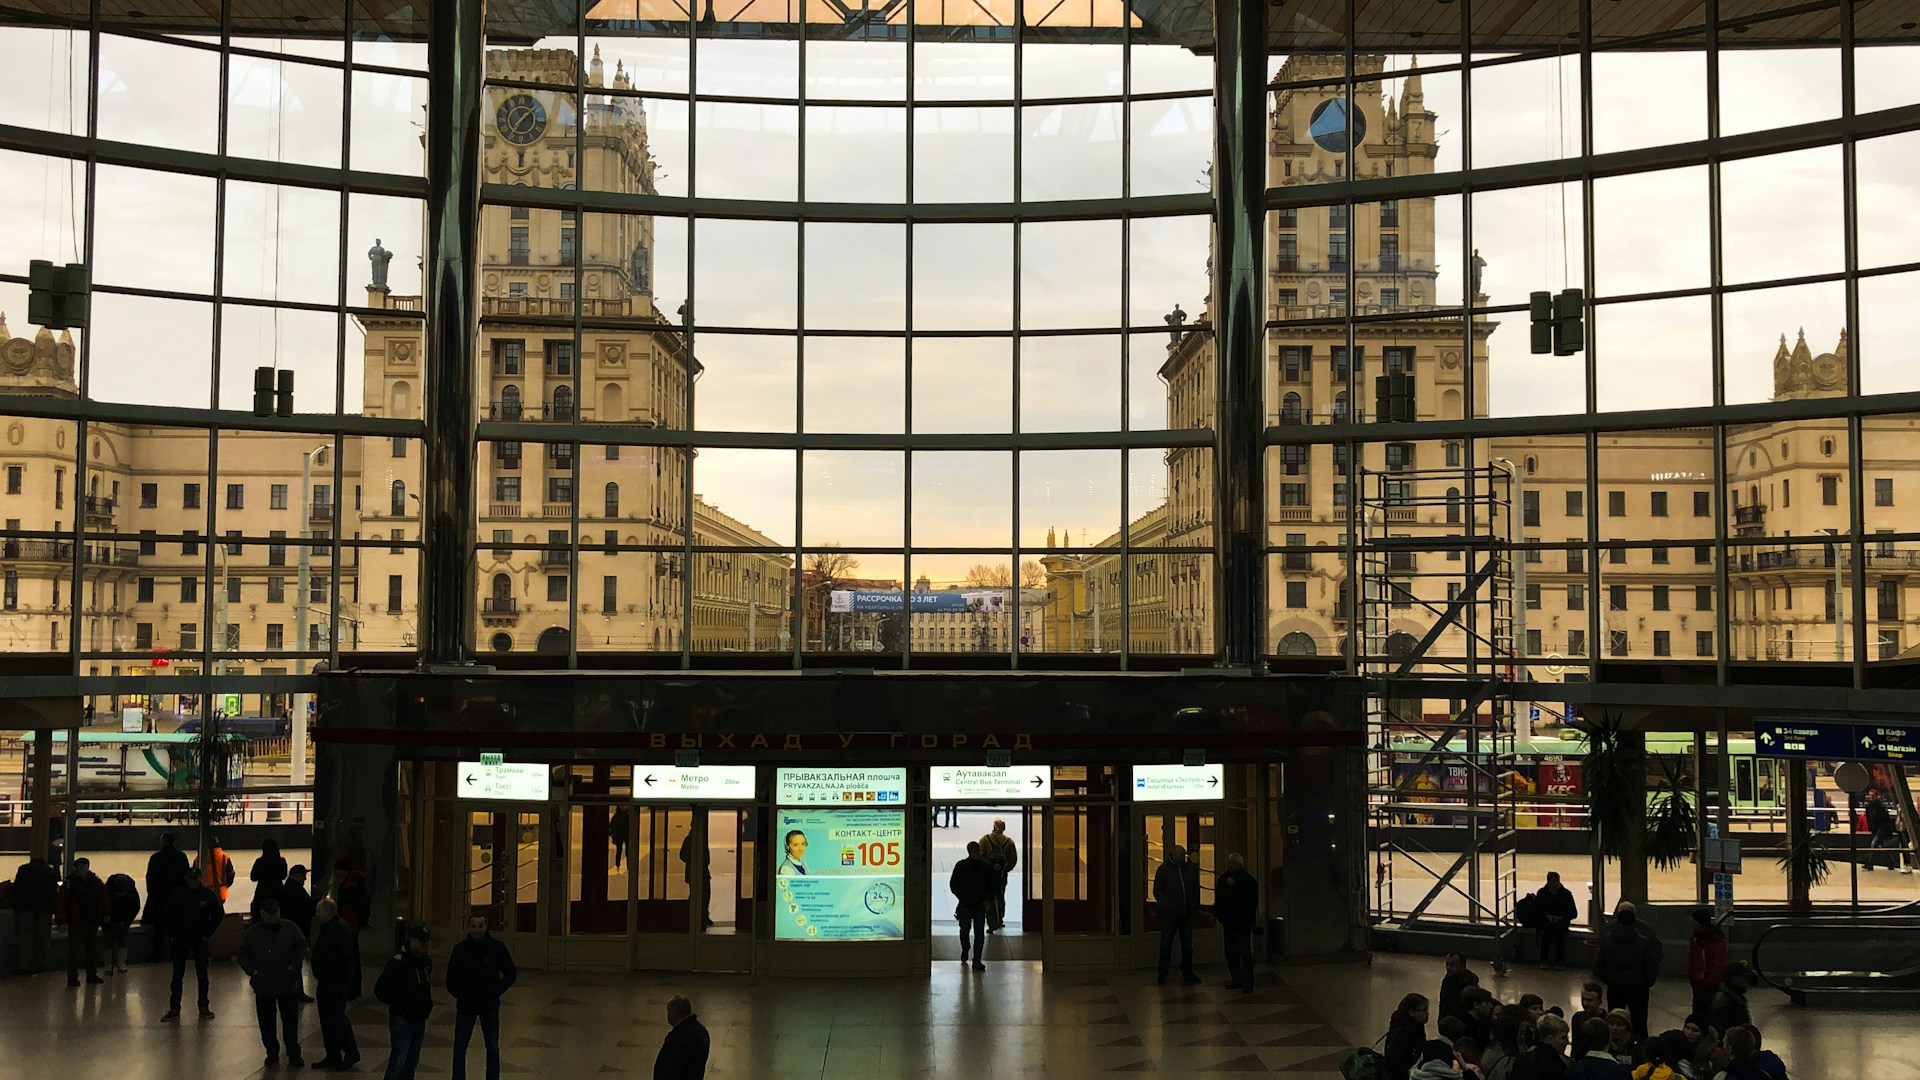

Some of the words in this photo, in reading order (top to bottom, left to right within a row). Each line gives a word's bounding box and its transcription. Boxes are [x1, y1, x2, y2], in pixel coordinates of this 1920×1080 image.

[857, 594, 903, 603] РАССРОЧКА
[1885, 729, 1906, 737] Кафэ
[650, 733, 802, 751] ВЫХАД
[840, 733, 855, 748] У
[890, 733, 1033, 751] ГОРАД
[1886, 744, 1917, 753] Магазін
[783, 773, 865, 781] ПРЫВАКЗАЛЬНАЯ
[955, 769, 1007, 779] Аўтавакзал
[681, 774, 709, 784] Метро
[846, 782, 869, 790] plošča
[1547, 785, 1576, 797] KFC
[835, 829, 902, 838] КОНТАКТ-ЦЕНТР
[857, 842, 901, 866] 105
